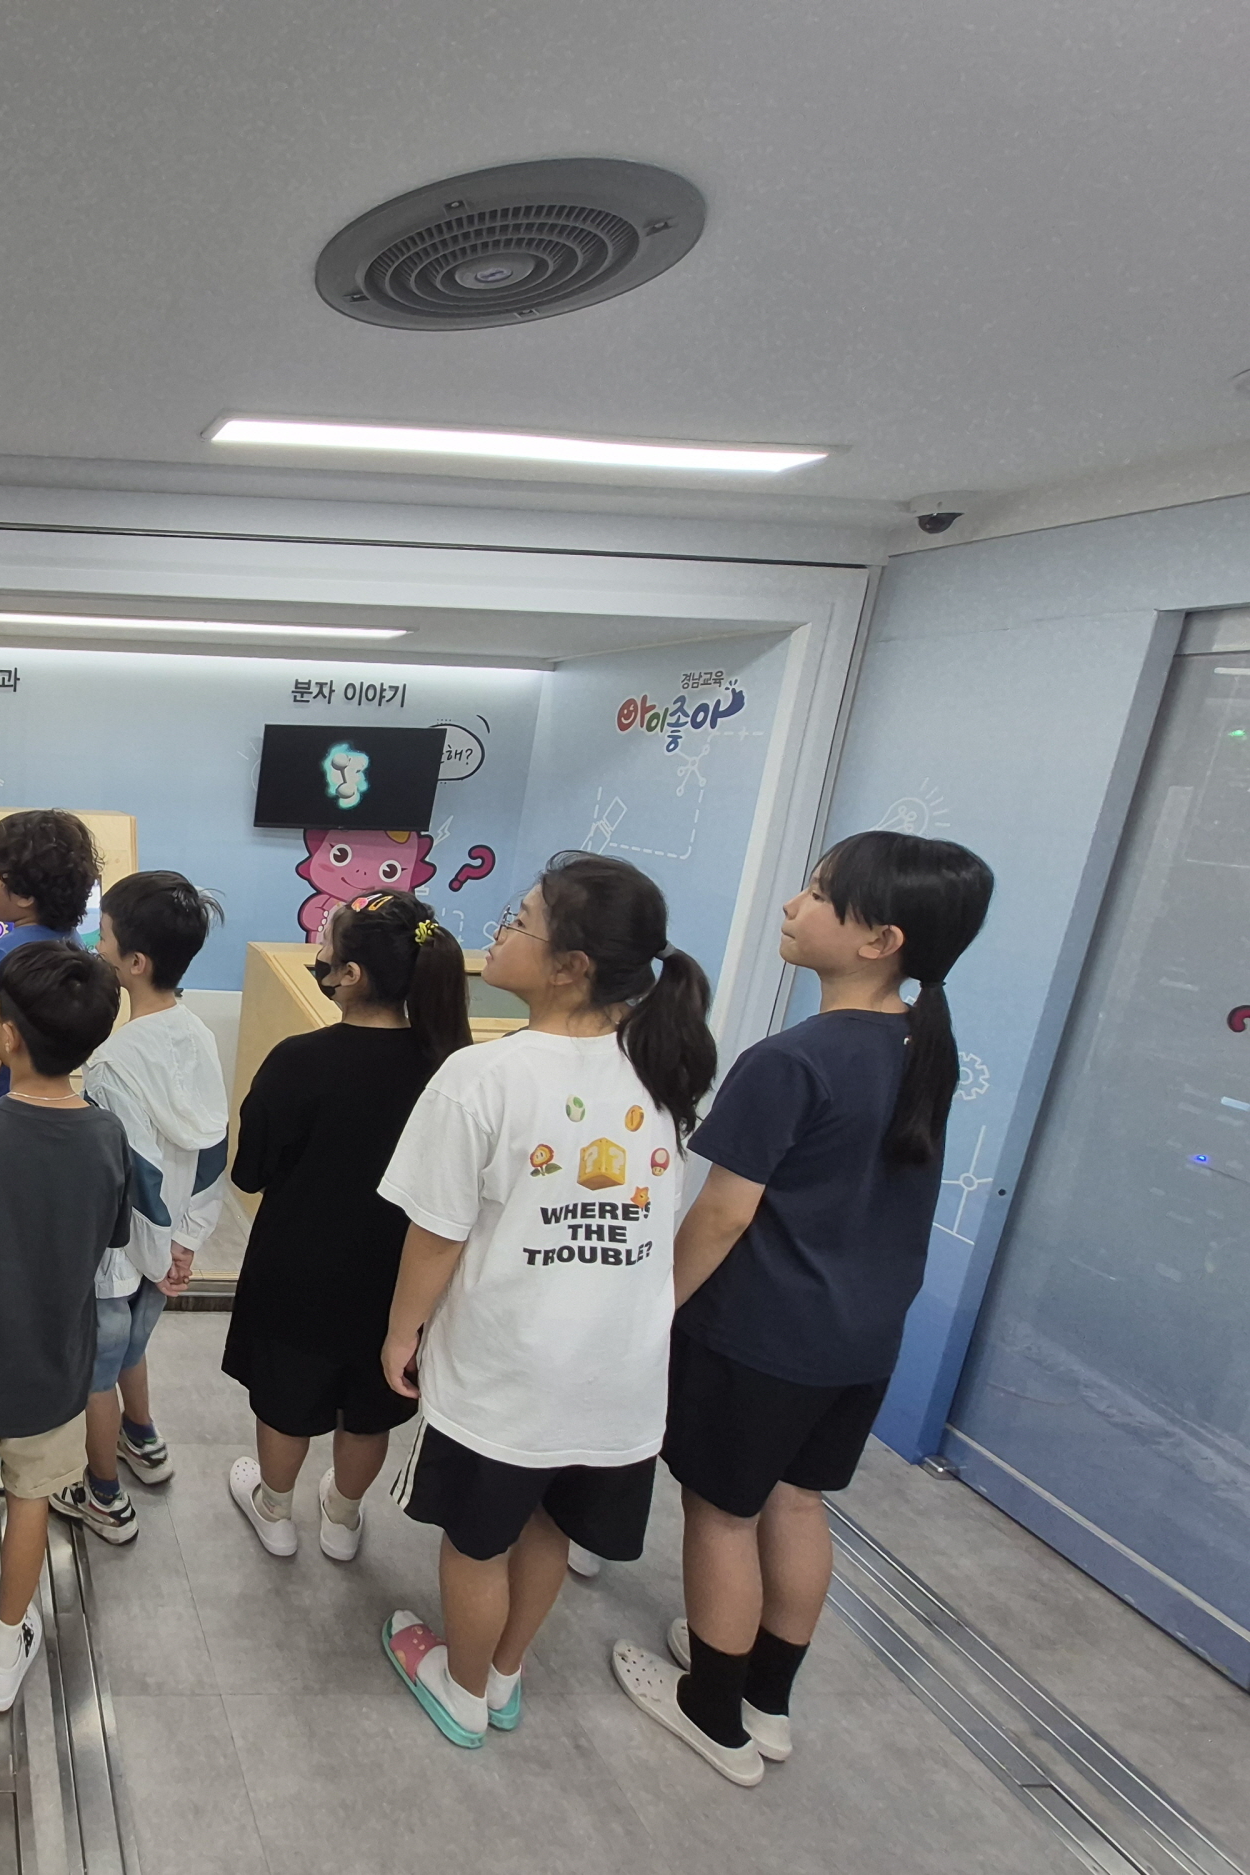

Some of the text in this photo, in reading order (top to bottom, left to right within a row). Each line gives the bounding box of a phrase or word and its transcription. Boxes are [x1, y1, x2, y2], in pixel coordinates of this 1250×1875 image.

[681, 670, 724, 689] 경남교육
[291, 678, 407, 707] 분자 이야기
[616, 694, 746, 753] 아이좋아
[440, 744, 473, 765] 해?
[567, 1223, 627, 1243] THE
[523, 1240, 652, 1266] TROUBLE?
